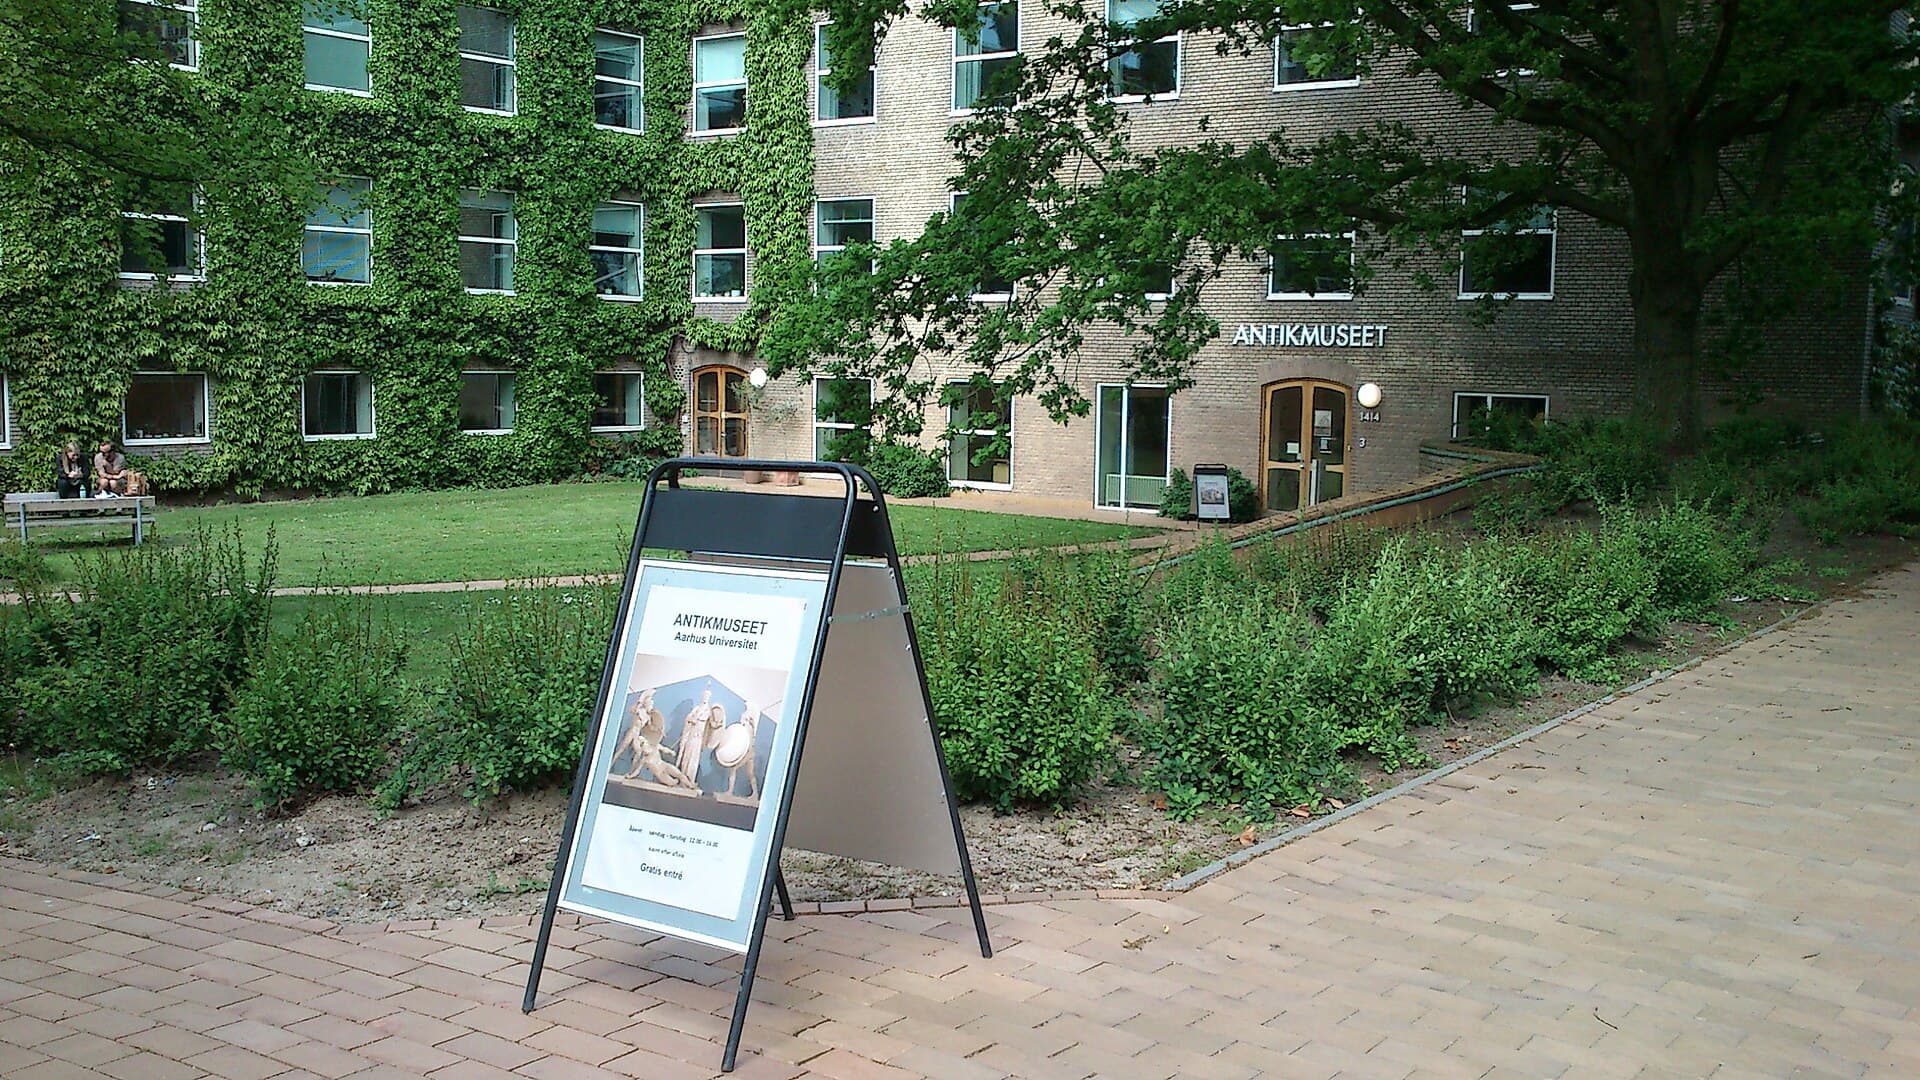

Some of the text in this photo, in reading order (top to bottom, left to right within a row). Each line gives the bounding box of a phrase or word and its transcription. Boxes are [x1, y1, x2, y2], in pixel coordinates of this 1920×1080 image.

[1232, 323, 1388, 347] ANTIKMUSEET
[1360, 411, 1380, 421] 1414
[1359, 437, 1366, 447] 3
[673, 613, 768, 635] ANTIKMUSEET
[674, 631, 758, 650] Aarhus Universitet
[640, 862, 683, 880] Gratis entré
